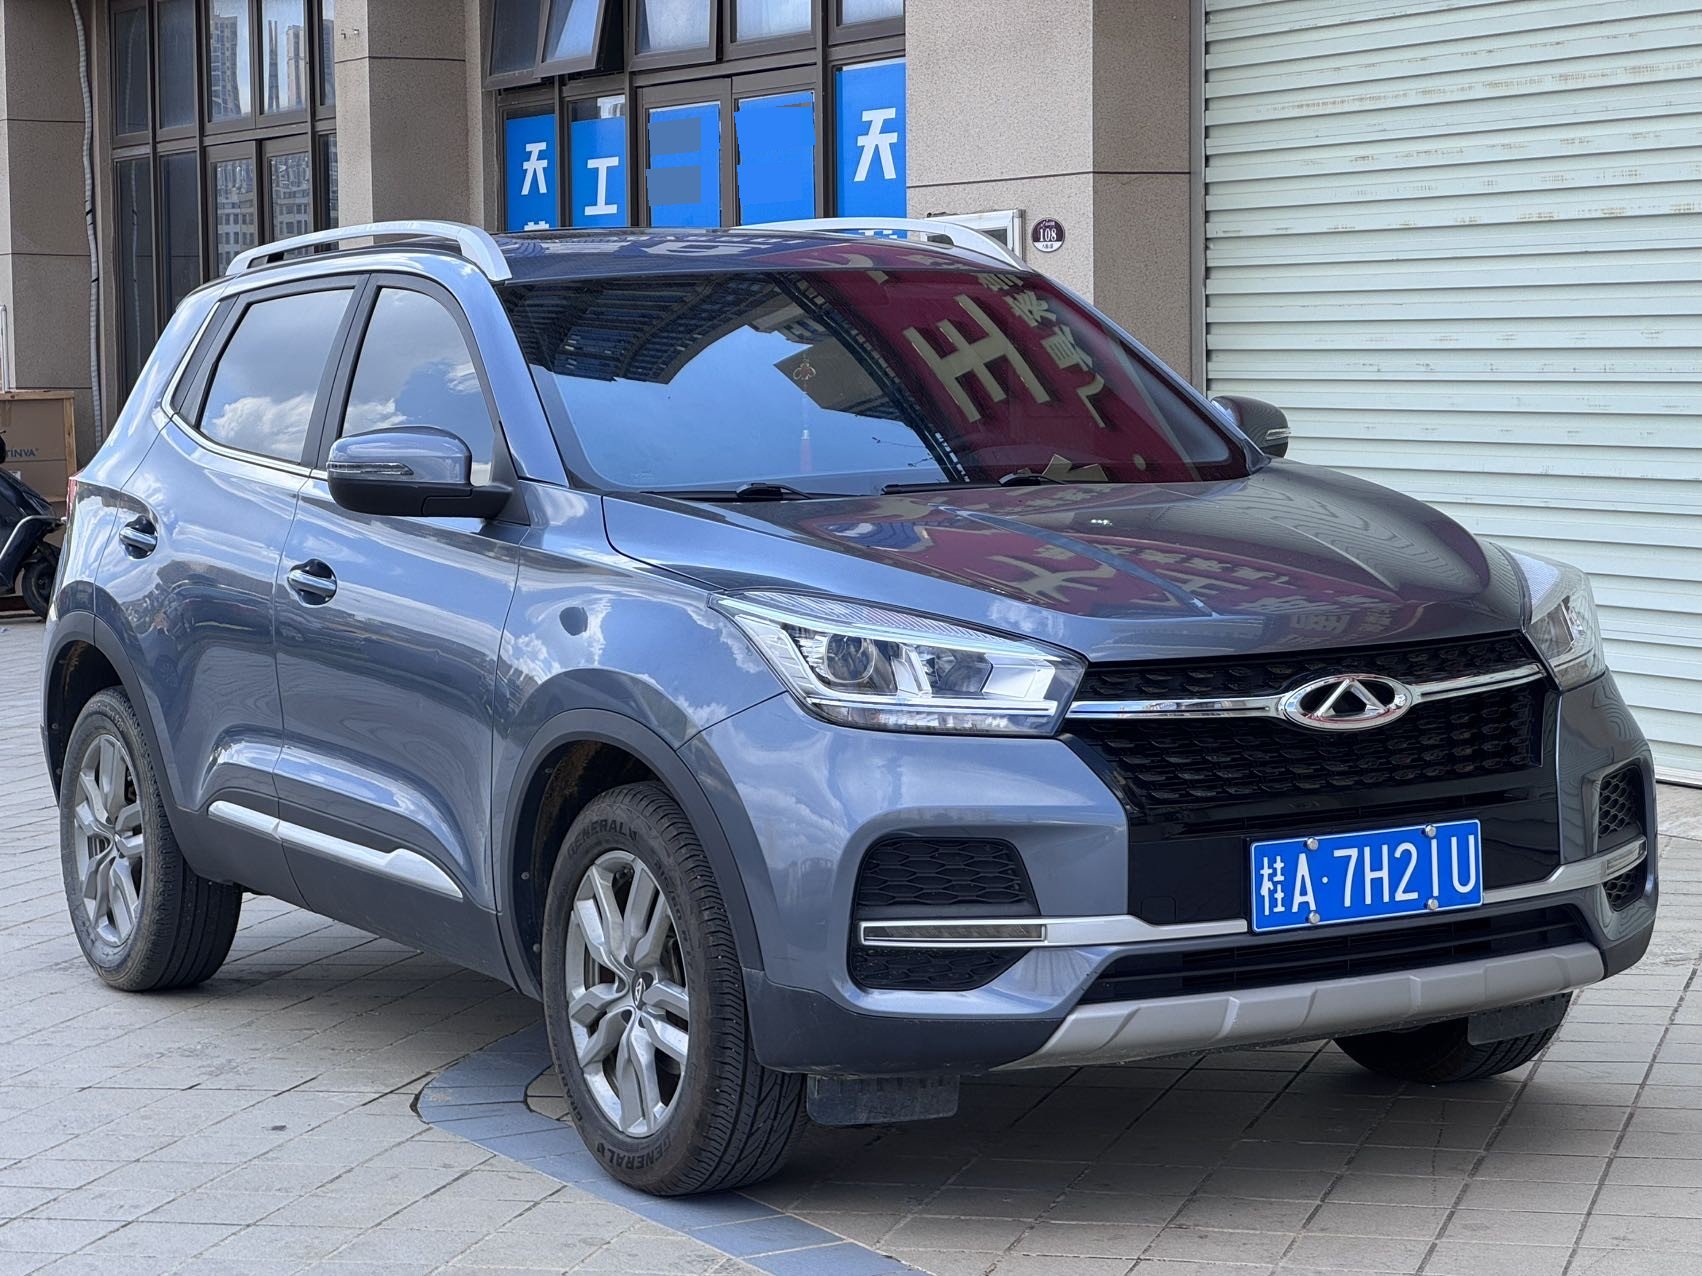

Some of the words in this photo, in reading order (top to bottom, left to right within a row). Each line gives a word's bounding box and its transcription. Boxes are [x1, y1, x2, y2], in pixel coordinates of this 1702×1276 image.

[584, 156, 619, 215] 工
[1039, 228, 1057, 242] 108
[567, 818, 627, 857] GENERAL
[603, 1134, 672, 1170] GENERAL
